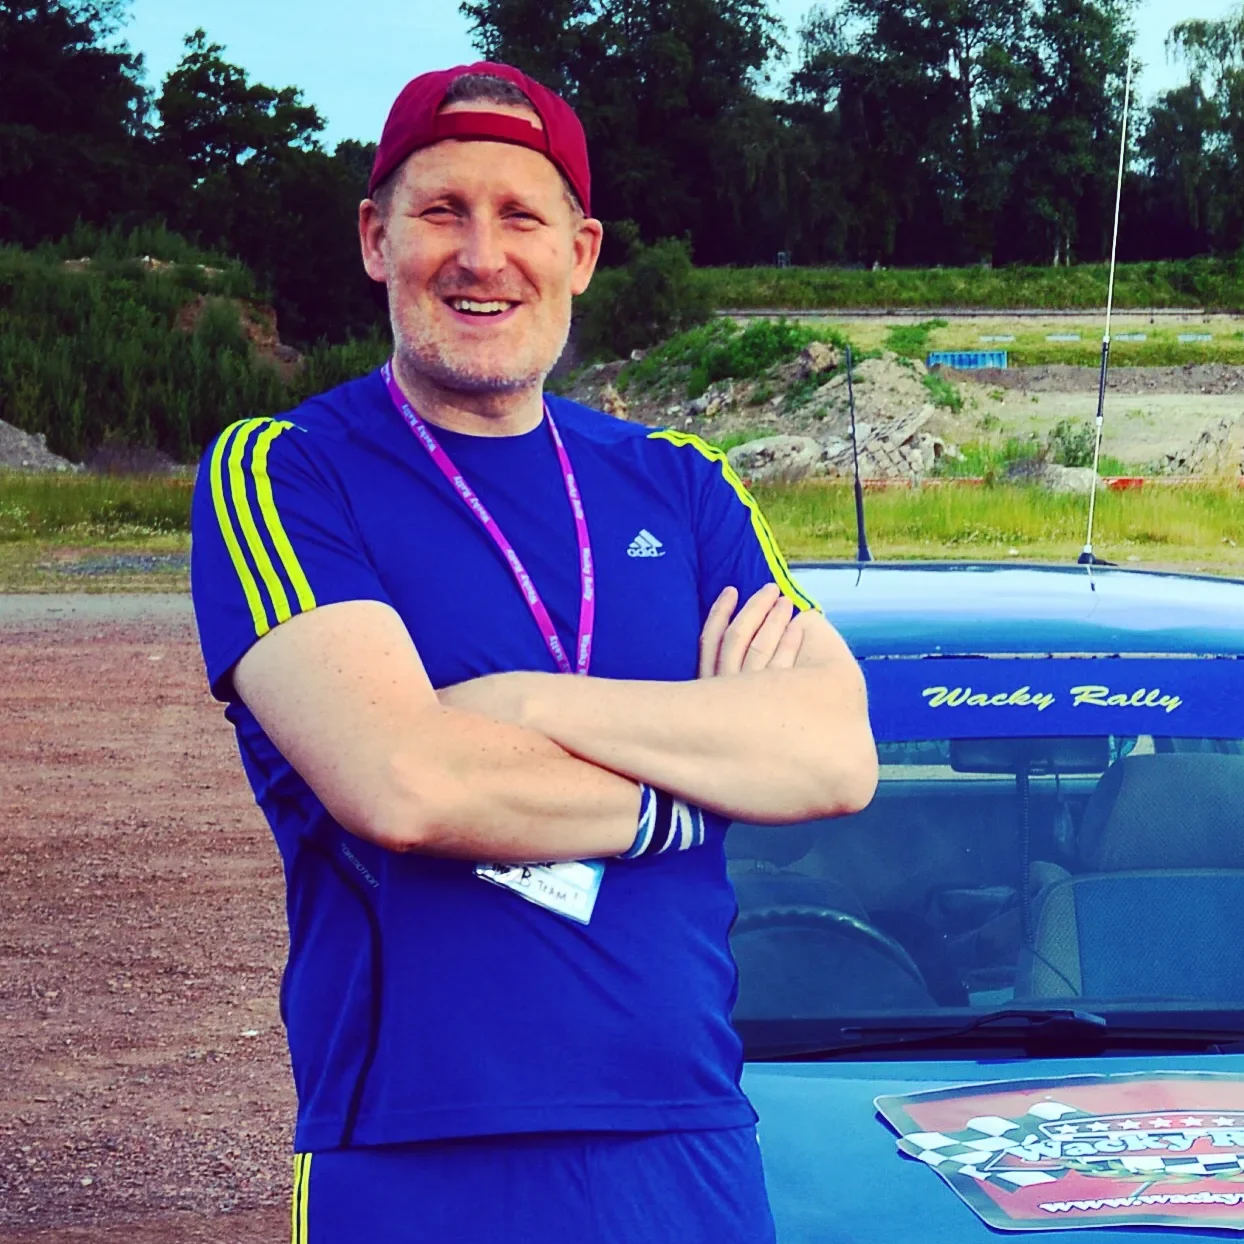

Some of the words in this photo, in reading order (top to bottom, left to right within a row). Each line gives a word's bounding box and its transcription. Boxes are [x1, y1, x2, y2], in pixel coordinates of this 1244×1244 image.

[921, 685, 1056, 711] Wacky
[1069, 685, 1183, 713] Rally
[1010, 1132, 1197, 1162] Wacky
